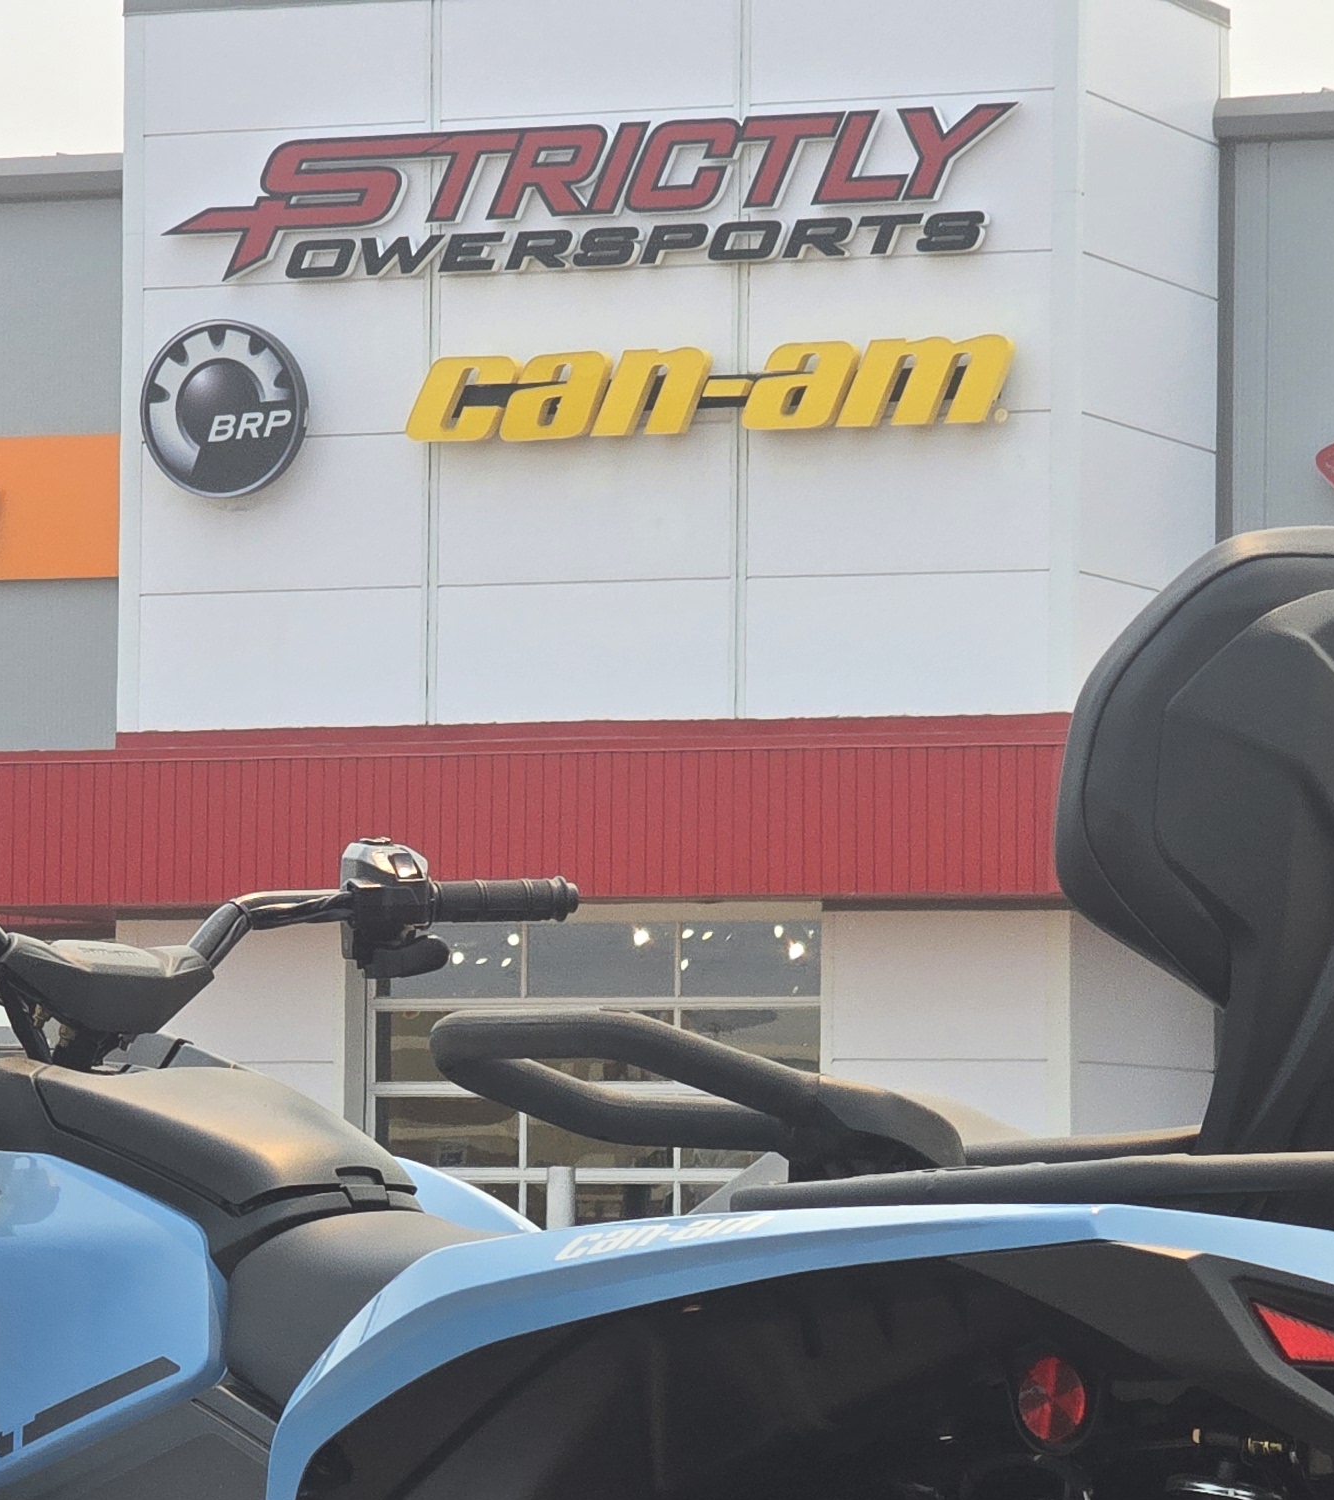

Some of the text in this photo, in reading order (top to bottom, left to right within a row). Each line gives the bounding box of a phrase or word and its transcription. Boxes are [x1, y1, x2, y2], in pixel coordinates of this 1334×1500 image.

[161, 102, 1021, 282] STRICTLY
[207, 408, 292, 445] BRP
[405, 333, 1015, 444] can-am
[554, 1214, 775, 1262] can-am
